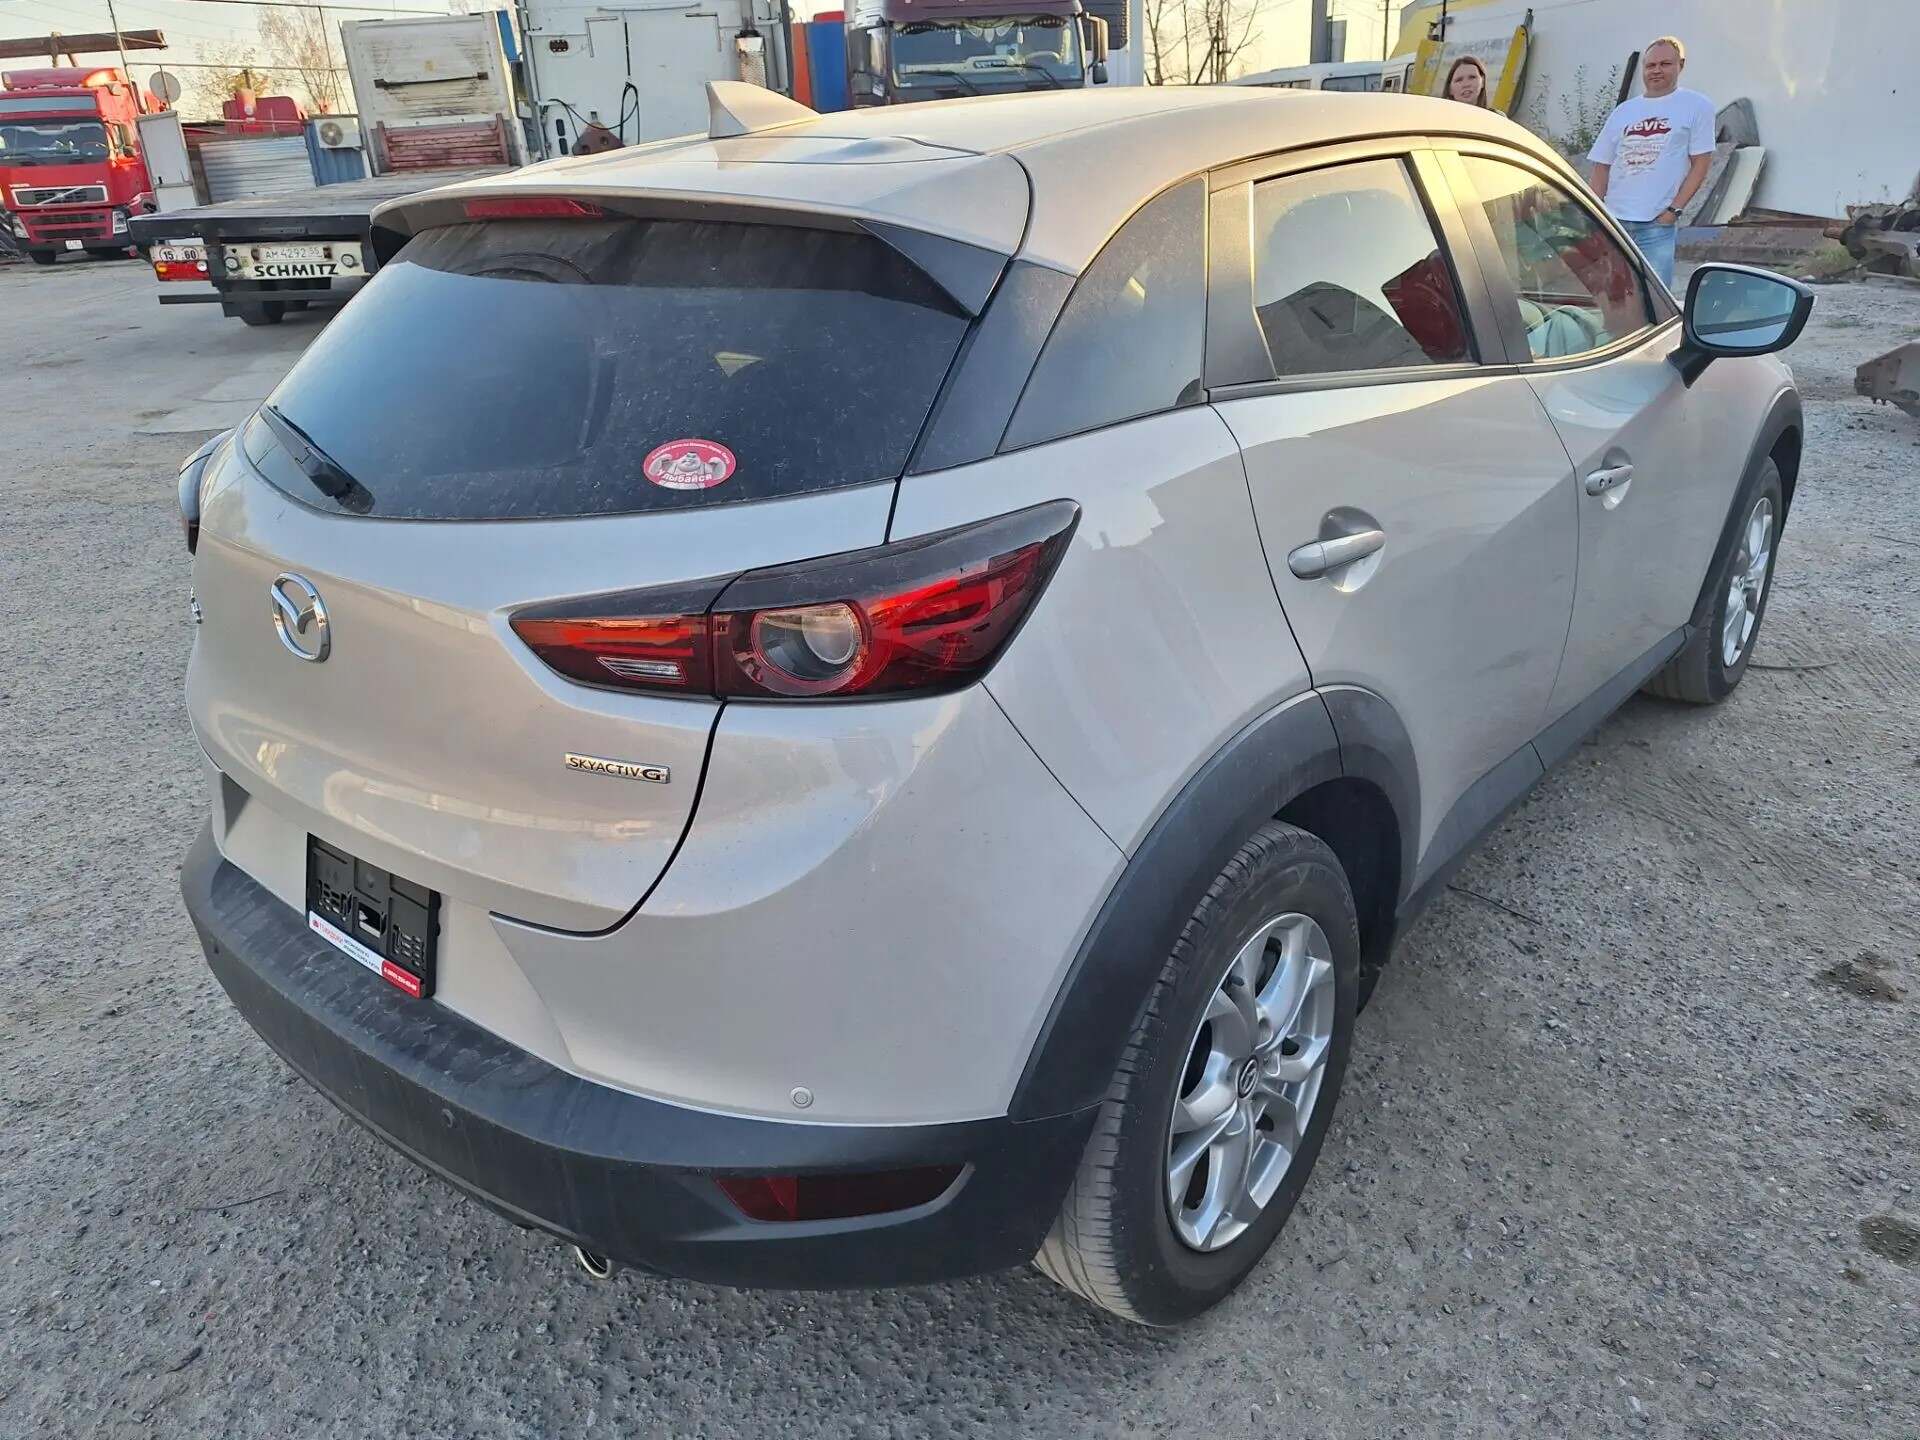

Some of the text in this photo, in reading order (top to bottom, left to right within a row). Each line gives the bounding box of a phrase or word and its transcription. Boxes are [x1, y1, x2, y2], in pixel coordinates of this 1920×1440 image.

[163, 251, 174, 260] 15
[184, 250, 197, 259] 60
[254, 263, 339, 277] SCHMITZ
[656, 469, 713, 483] Улыбайся
